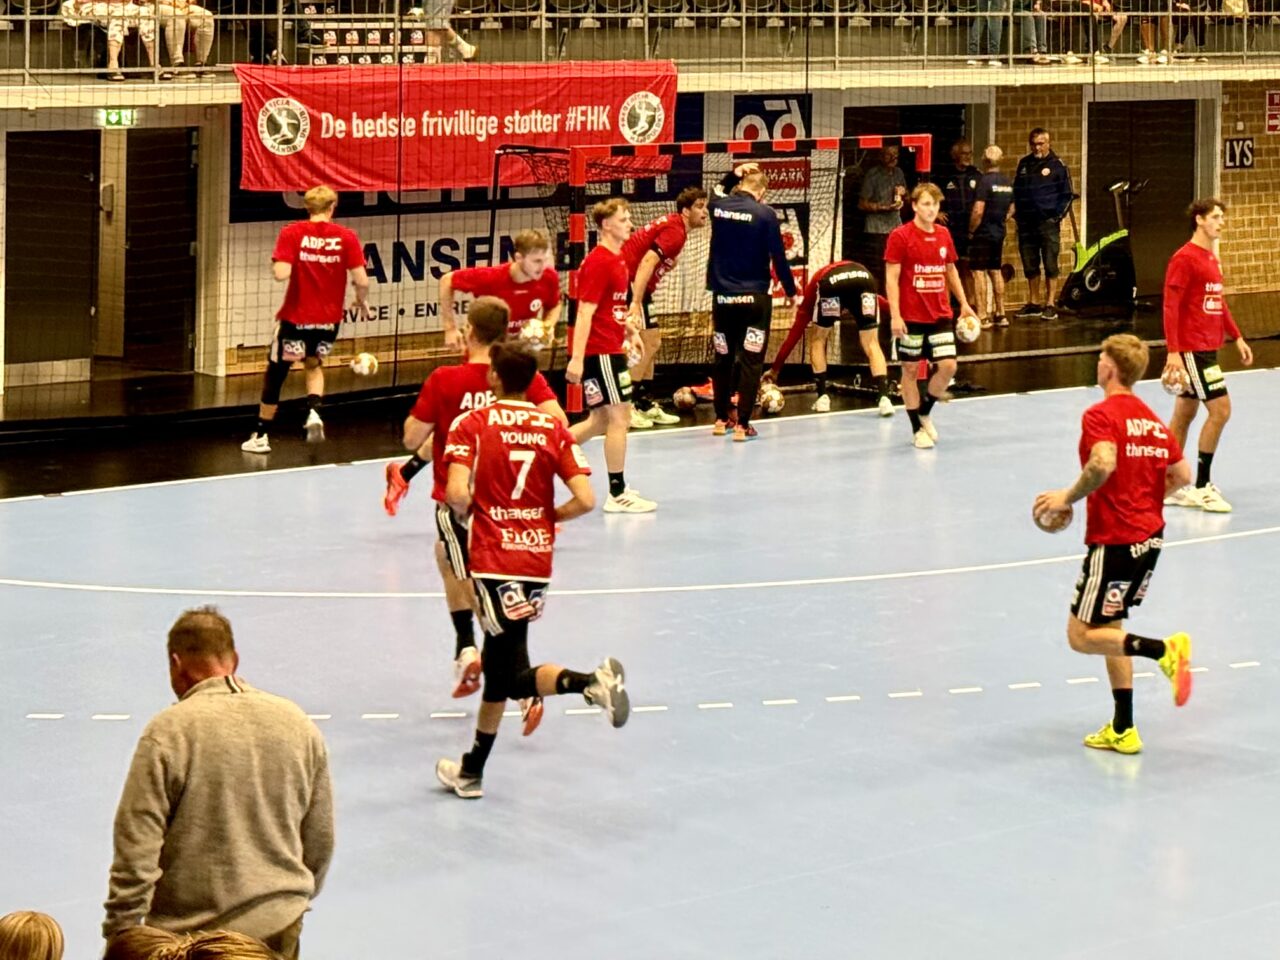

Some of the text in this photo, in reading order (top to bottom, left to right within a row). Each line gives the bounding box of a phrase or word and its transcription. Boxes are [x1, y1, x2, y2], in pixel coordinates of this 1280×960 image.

[320, 111, 347, 139] De
[351, 111, 416, 139] bedste
[422, 109, 499, 142] frivillige
[503, 108, 562, 135] støtter
[565, 104, 612, 132] #FHK
[1225, 139, 1253, 167] LYS
[713, 207, 753, 223] thansen
[299, 251, 341, 264] thansen
[829, 270, 870, 284] thansen
[717, 294, 755, 305] thansen
[499, 431, 548, 446] YOUNG
[509, 450, 537, 501] 7
